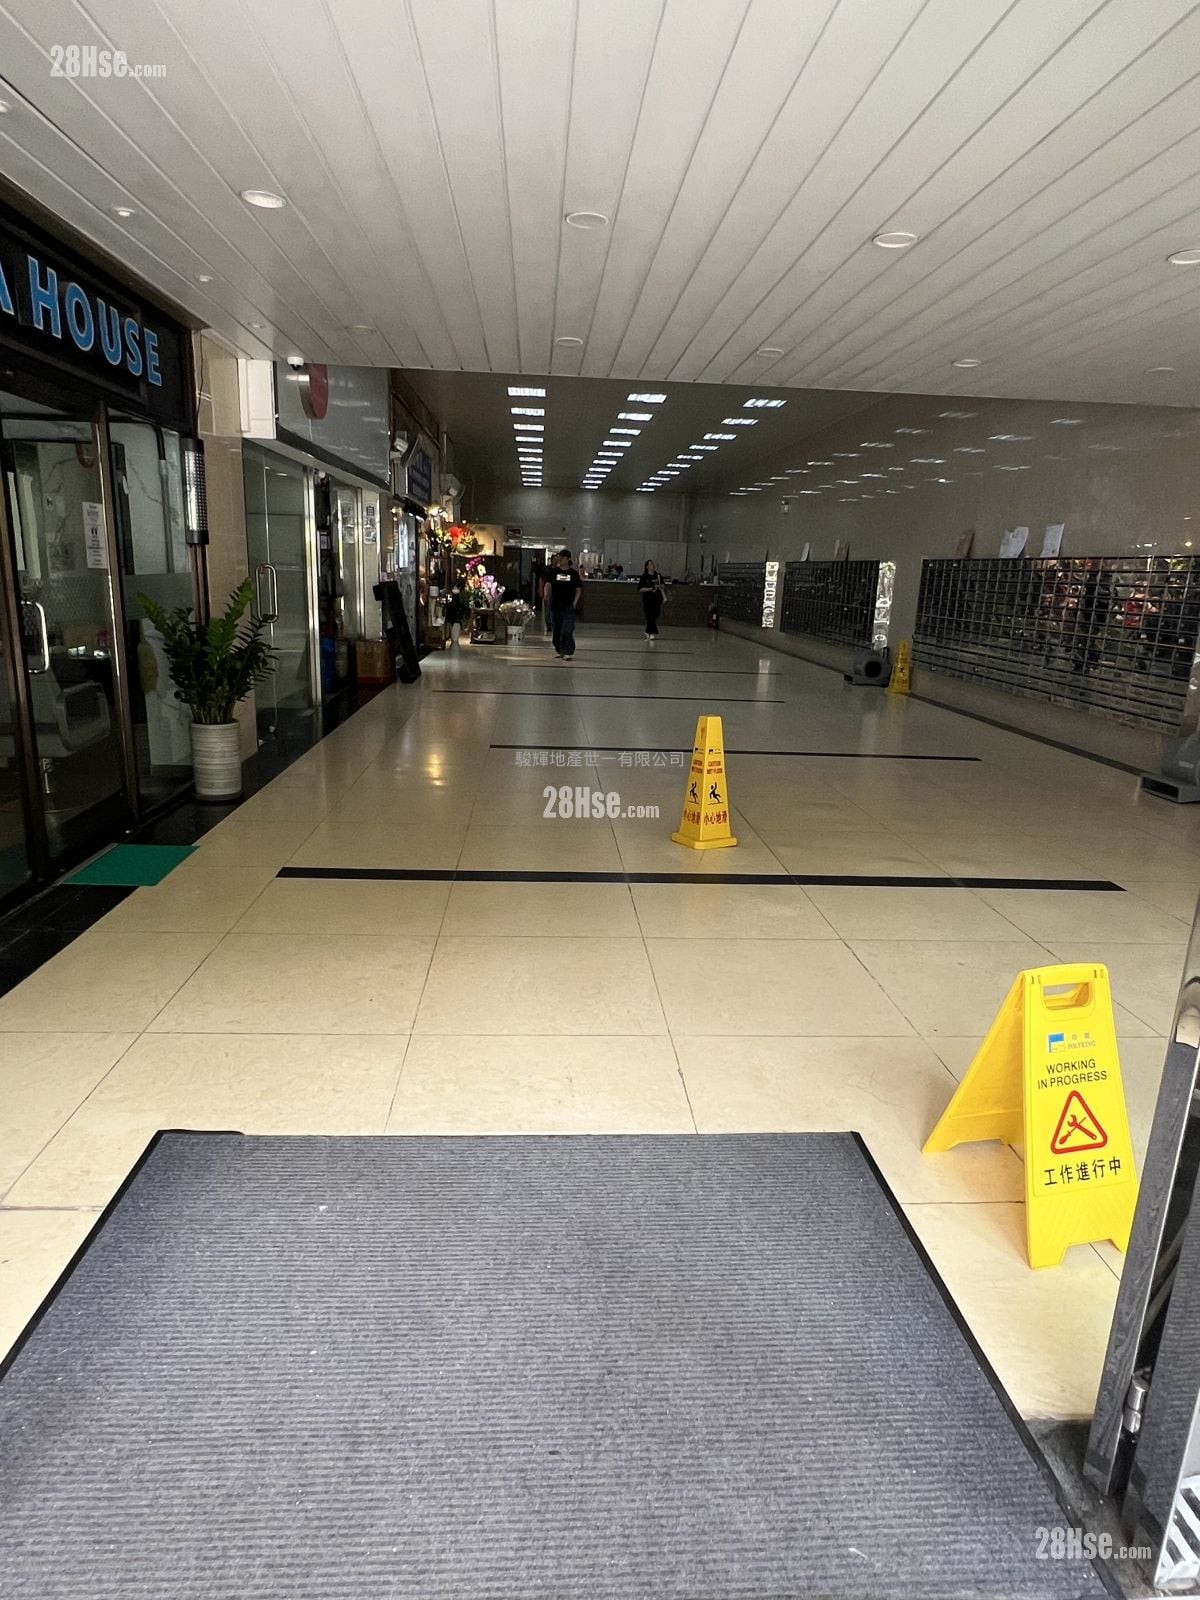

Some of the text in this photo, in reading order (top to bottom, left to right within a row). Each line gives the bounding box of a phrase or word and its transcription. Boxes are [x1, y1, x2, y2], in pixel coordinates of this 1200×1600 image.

[27, 254, 163, 387] HOUSE
[1046, 1058, 1096, 1074] WORKING
[1037, 1070, 1108, 1089] IN PROGRESS
[1043, 1155, 1121, 1187] 工作進行中
